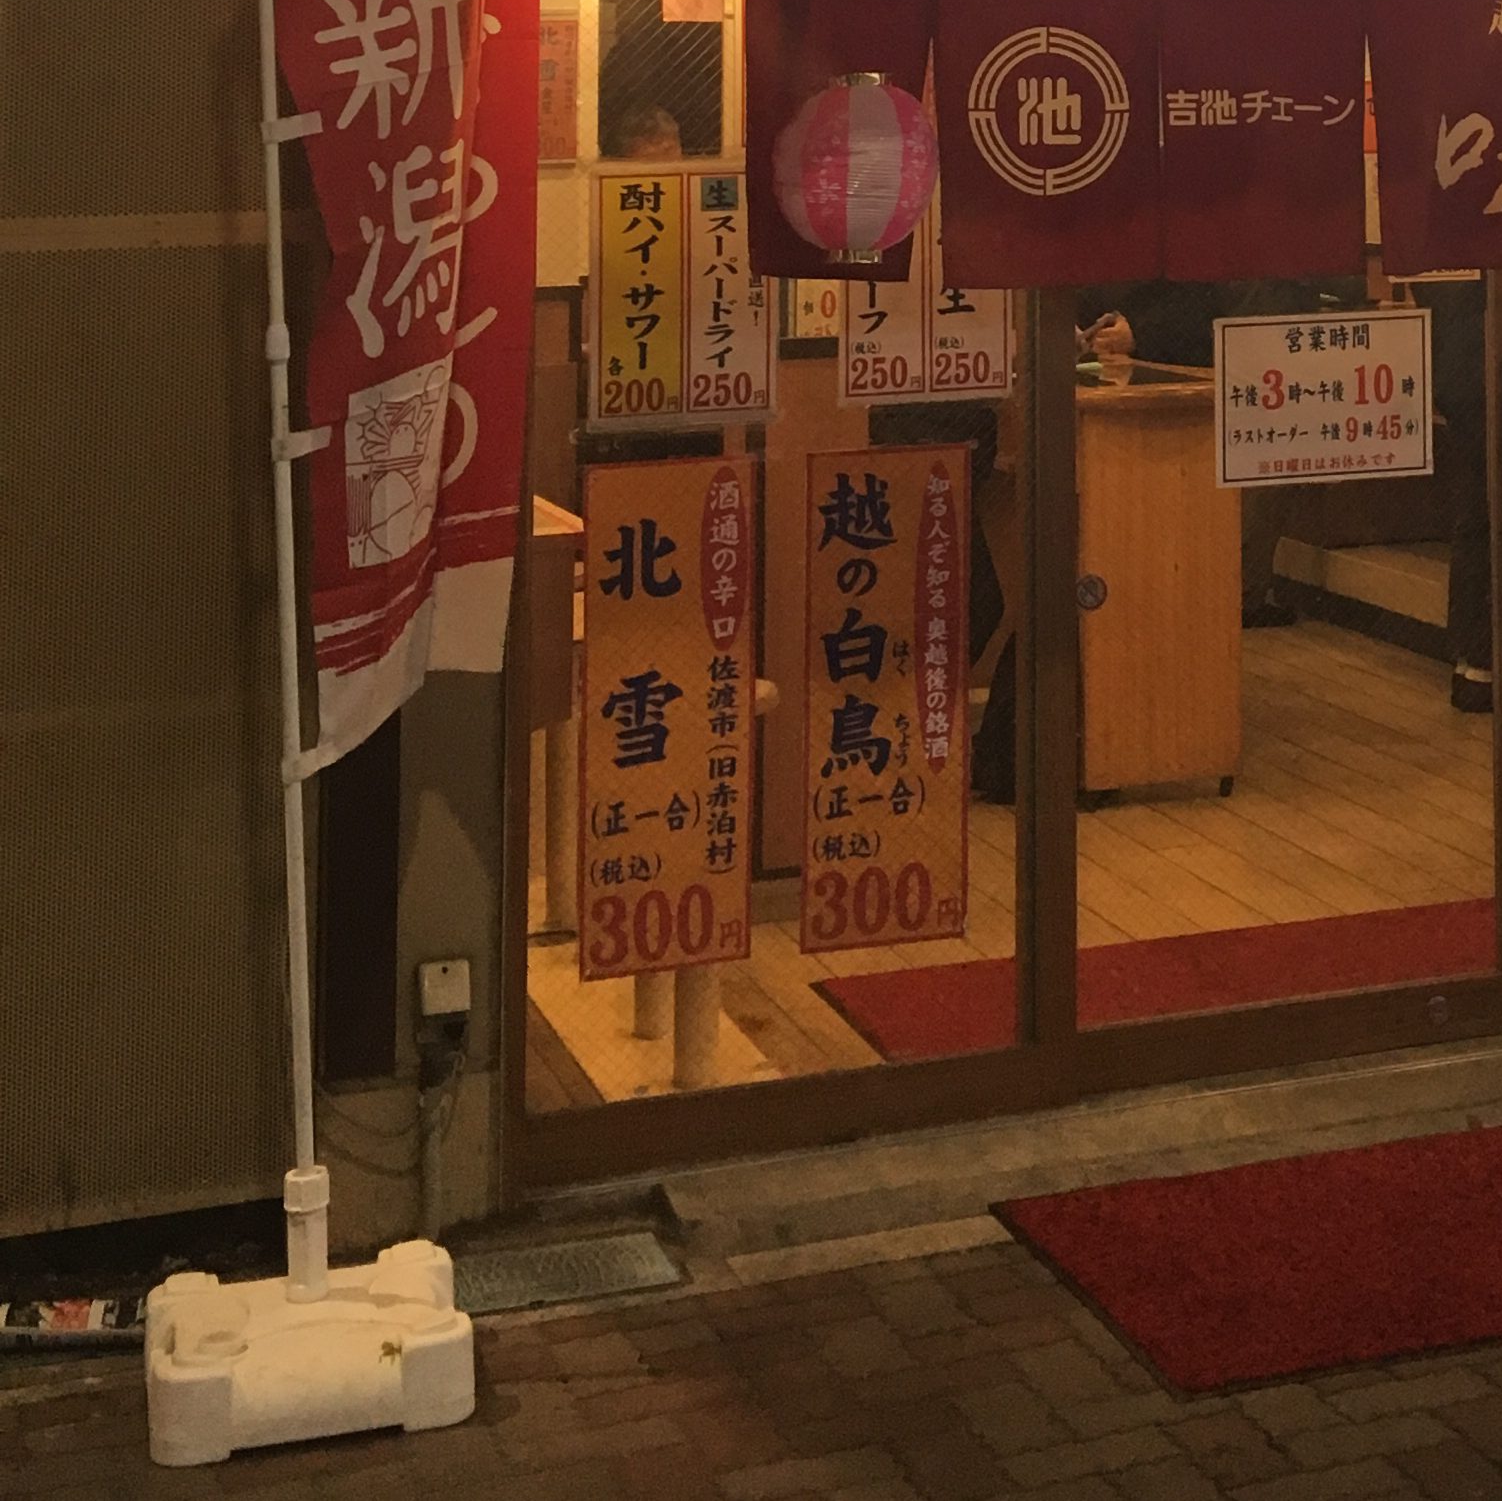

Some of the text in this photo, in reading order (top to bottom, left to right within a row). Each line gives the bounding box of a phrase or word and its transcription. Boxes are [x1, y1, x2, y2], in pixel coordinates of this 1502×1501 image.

[1017, 76, 1083, 146] 池
[1166, 89, 1356, 127] 吉池チェーン
[1284, 323, 1371, 354] 営業時間
[850, 355, 922, 391] 250円
[934, 350, 1004, 386] 250円
[604, 377, 681, 415] 200円
[693, 371, 766, 409] 250円
[708, 480, 741, 640] 酒通の辛口
[926, 474, 953, 609] 知る人ぞ知る
[599, 517, 683, 770] 北雪
[818, 471, 899, 780] 越の白鳥
[892, 641, 911, 678] はく
[590, 790, 701, 839] (正一合)
[812, 775, 926, 822] (正一合)
[813, 830, 881, 864] (税込)
[589, 853, 662, 887] (税込)
[811, 861, 963, 941] 300円
[588, 882, 744, 969] 300円
